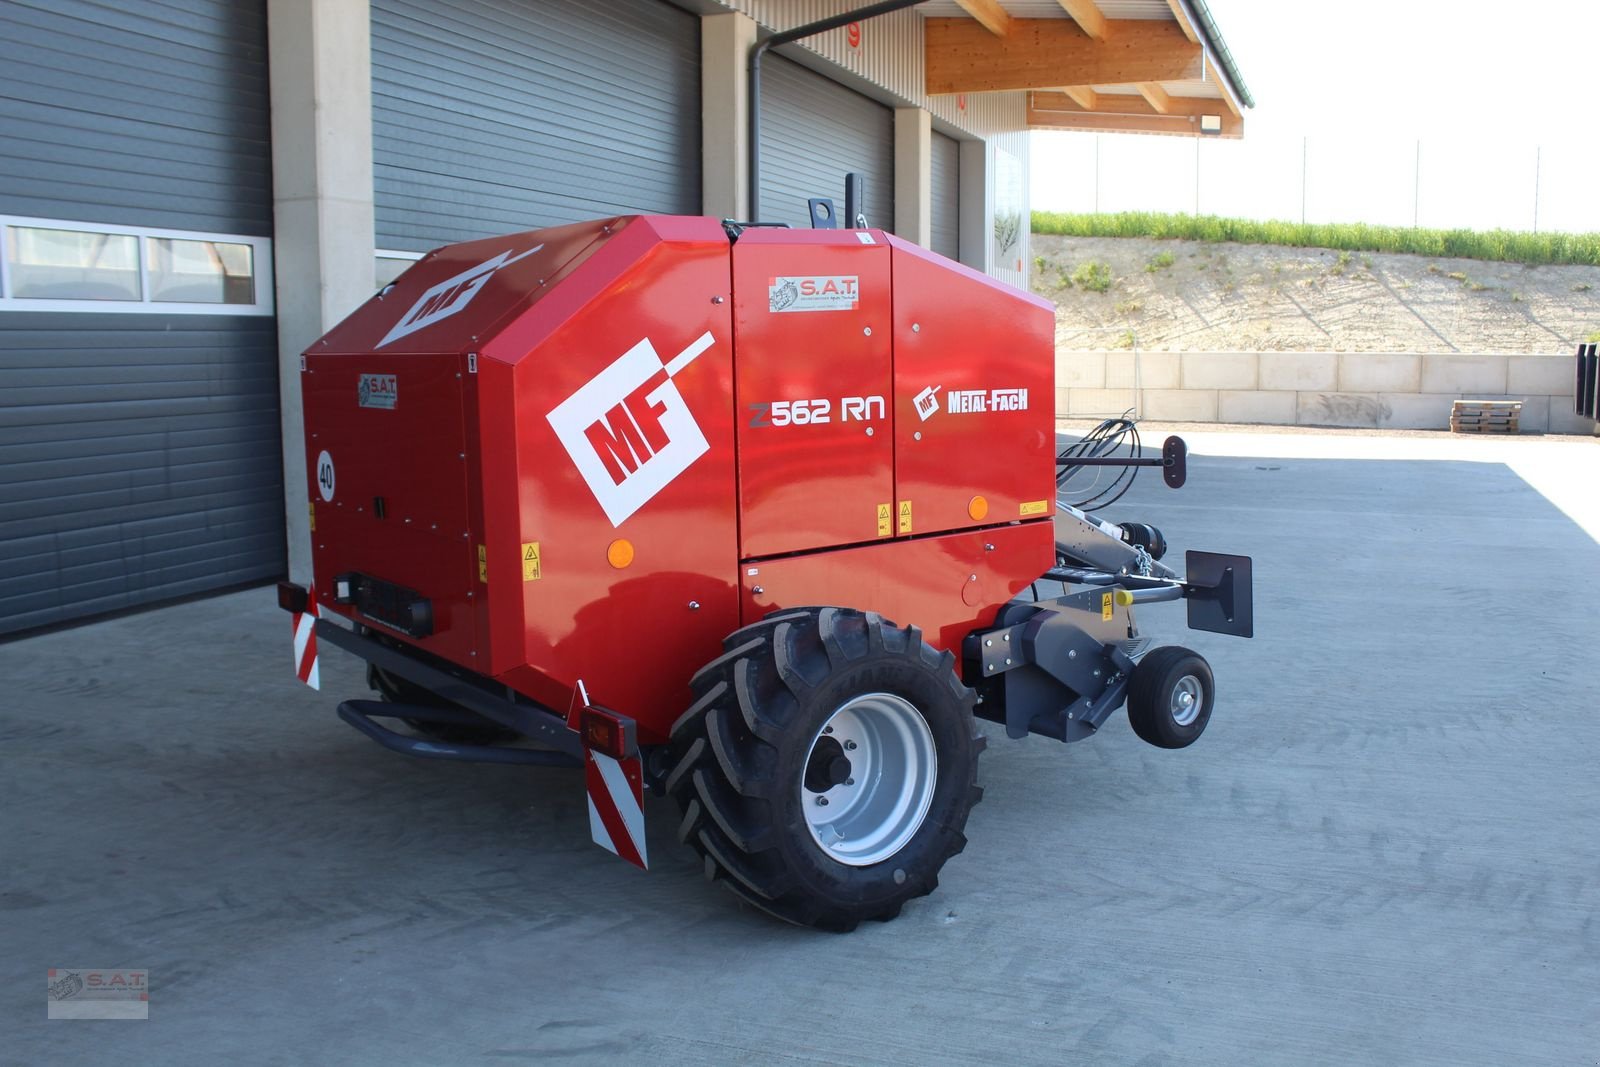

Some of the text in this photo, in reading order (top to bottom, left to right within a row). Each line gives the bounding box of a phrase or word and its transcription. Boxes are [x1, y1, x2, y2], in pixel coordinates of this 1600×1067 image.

[800, 279, 857, 296] S.A.T.
[919, 393, 934, 414] MF
[948, 388, 1028, 414] METAL-FACH
[583, 367, 671, 487] MF
[320, 463, 333, 490] 40
